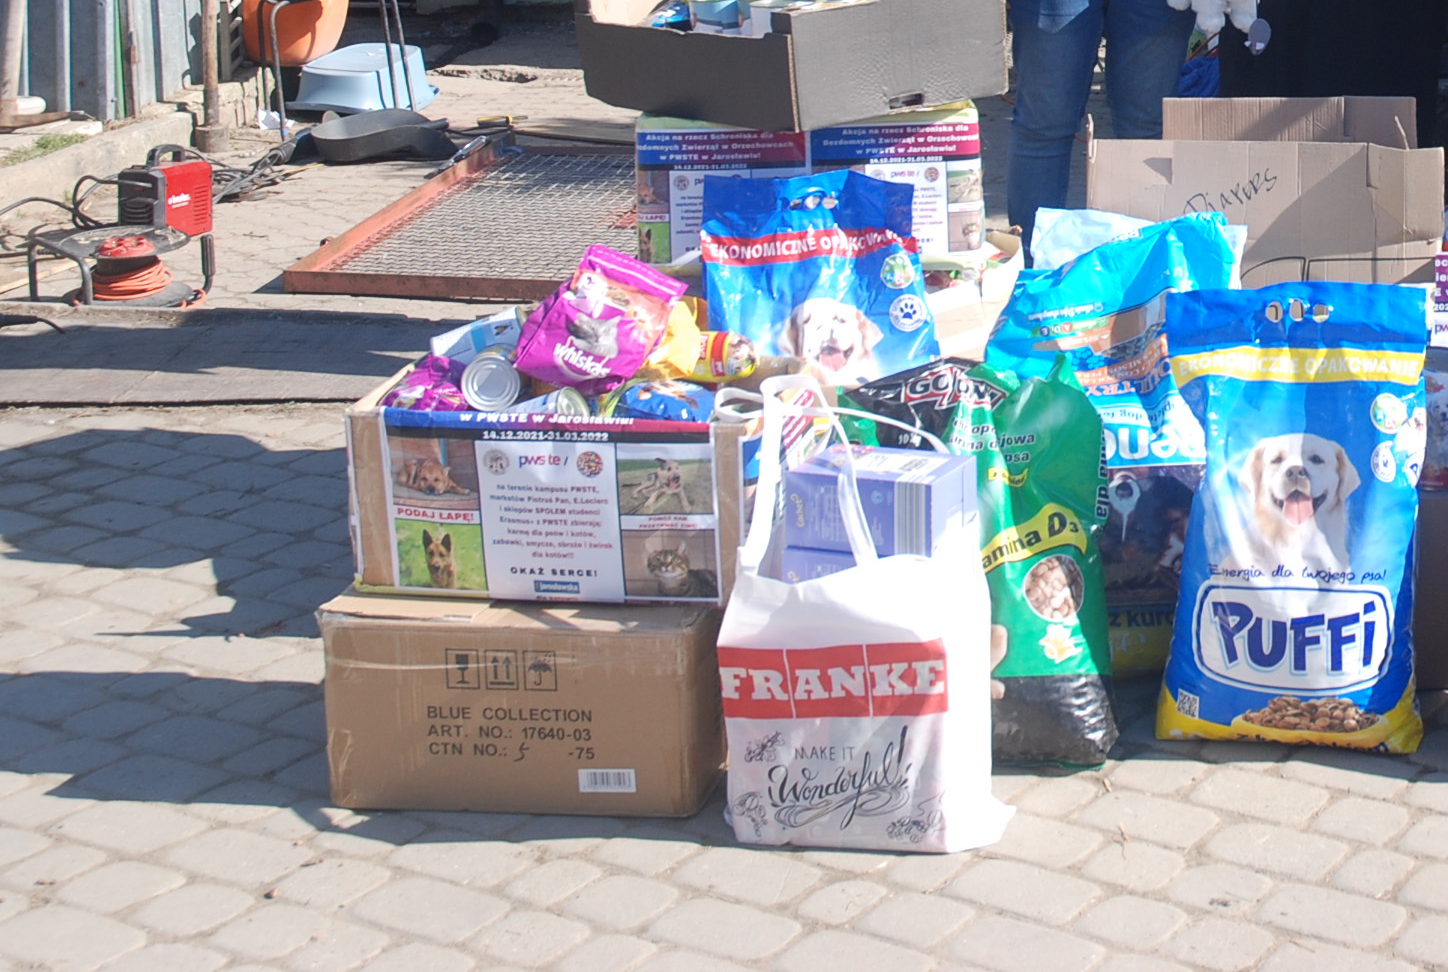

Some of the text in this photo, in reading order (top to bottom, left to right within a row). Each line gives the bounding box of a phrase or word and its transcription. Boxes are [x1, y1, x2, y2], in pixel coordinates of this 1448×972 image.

[708, 236, 817, 259] EKONOMICZNE
[1304, 356, 1419, 377] OPAKOWANIE
[1086, 358, 1171, 397] OULTRY
[477, 412, 528, 423] PWSTE
[532, 413, 546, 423] w
[482, 430, 609, 442] 14.12.2021-31.03.2022
[397, 508, 435, 519] PODAJ
[982, 528, 1042, 569] amina
[510, 566, 598, 577] OKAŻ SERCE!
[1271, 564, 1294, 577] dla
[1302, 566, 1356, 583] twojego
[718, 659, 945, 701] FRANKE
[427, 705, 593, 722] BLUE COLLECTION
[427, 724, 592, 741] ART. NO.: 17640-03
[428, 742, 507, 757] CTN NO.:
[794, 746, 857, 761] MAKE IT
